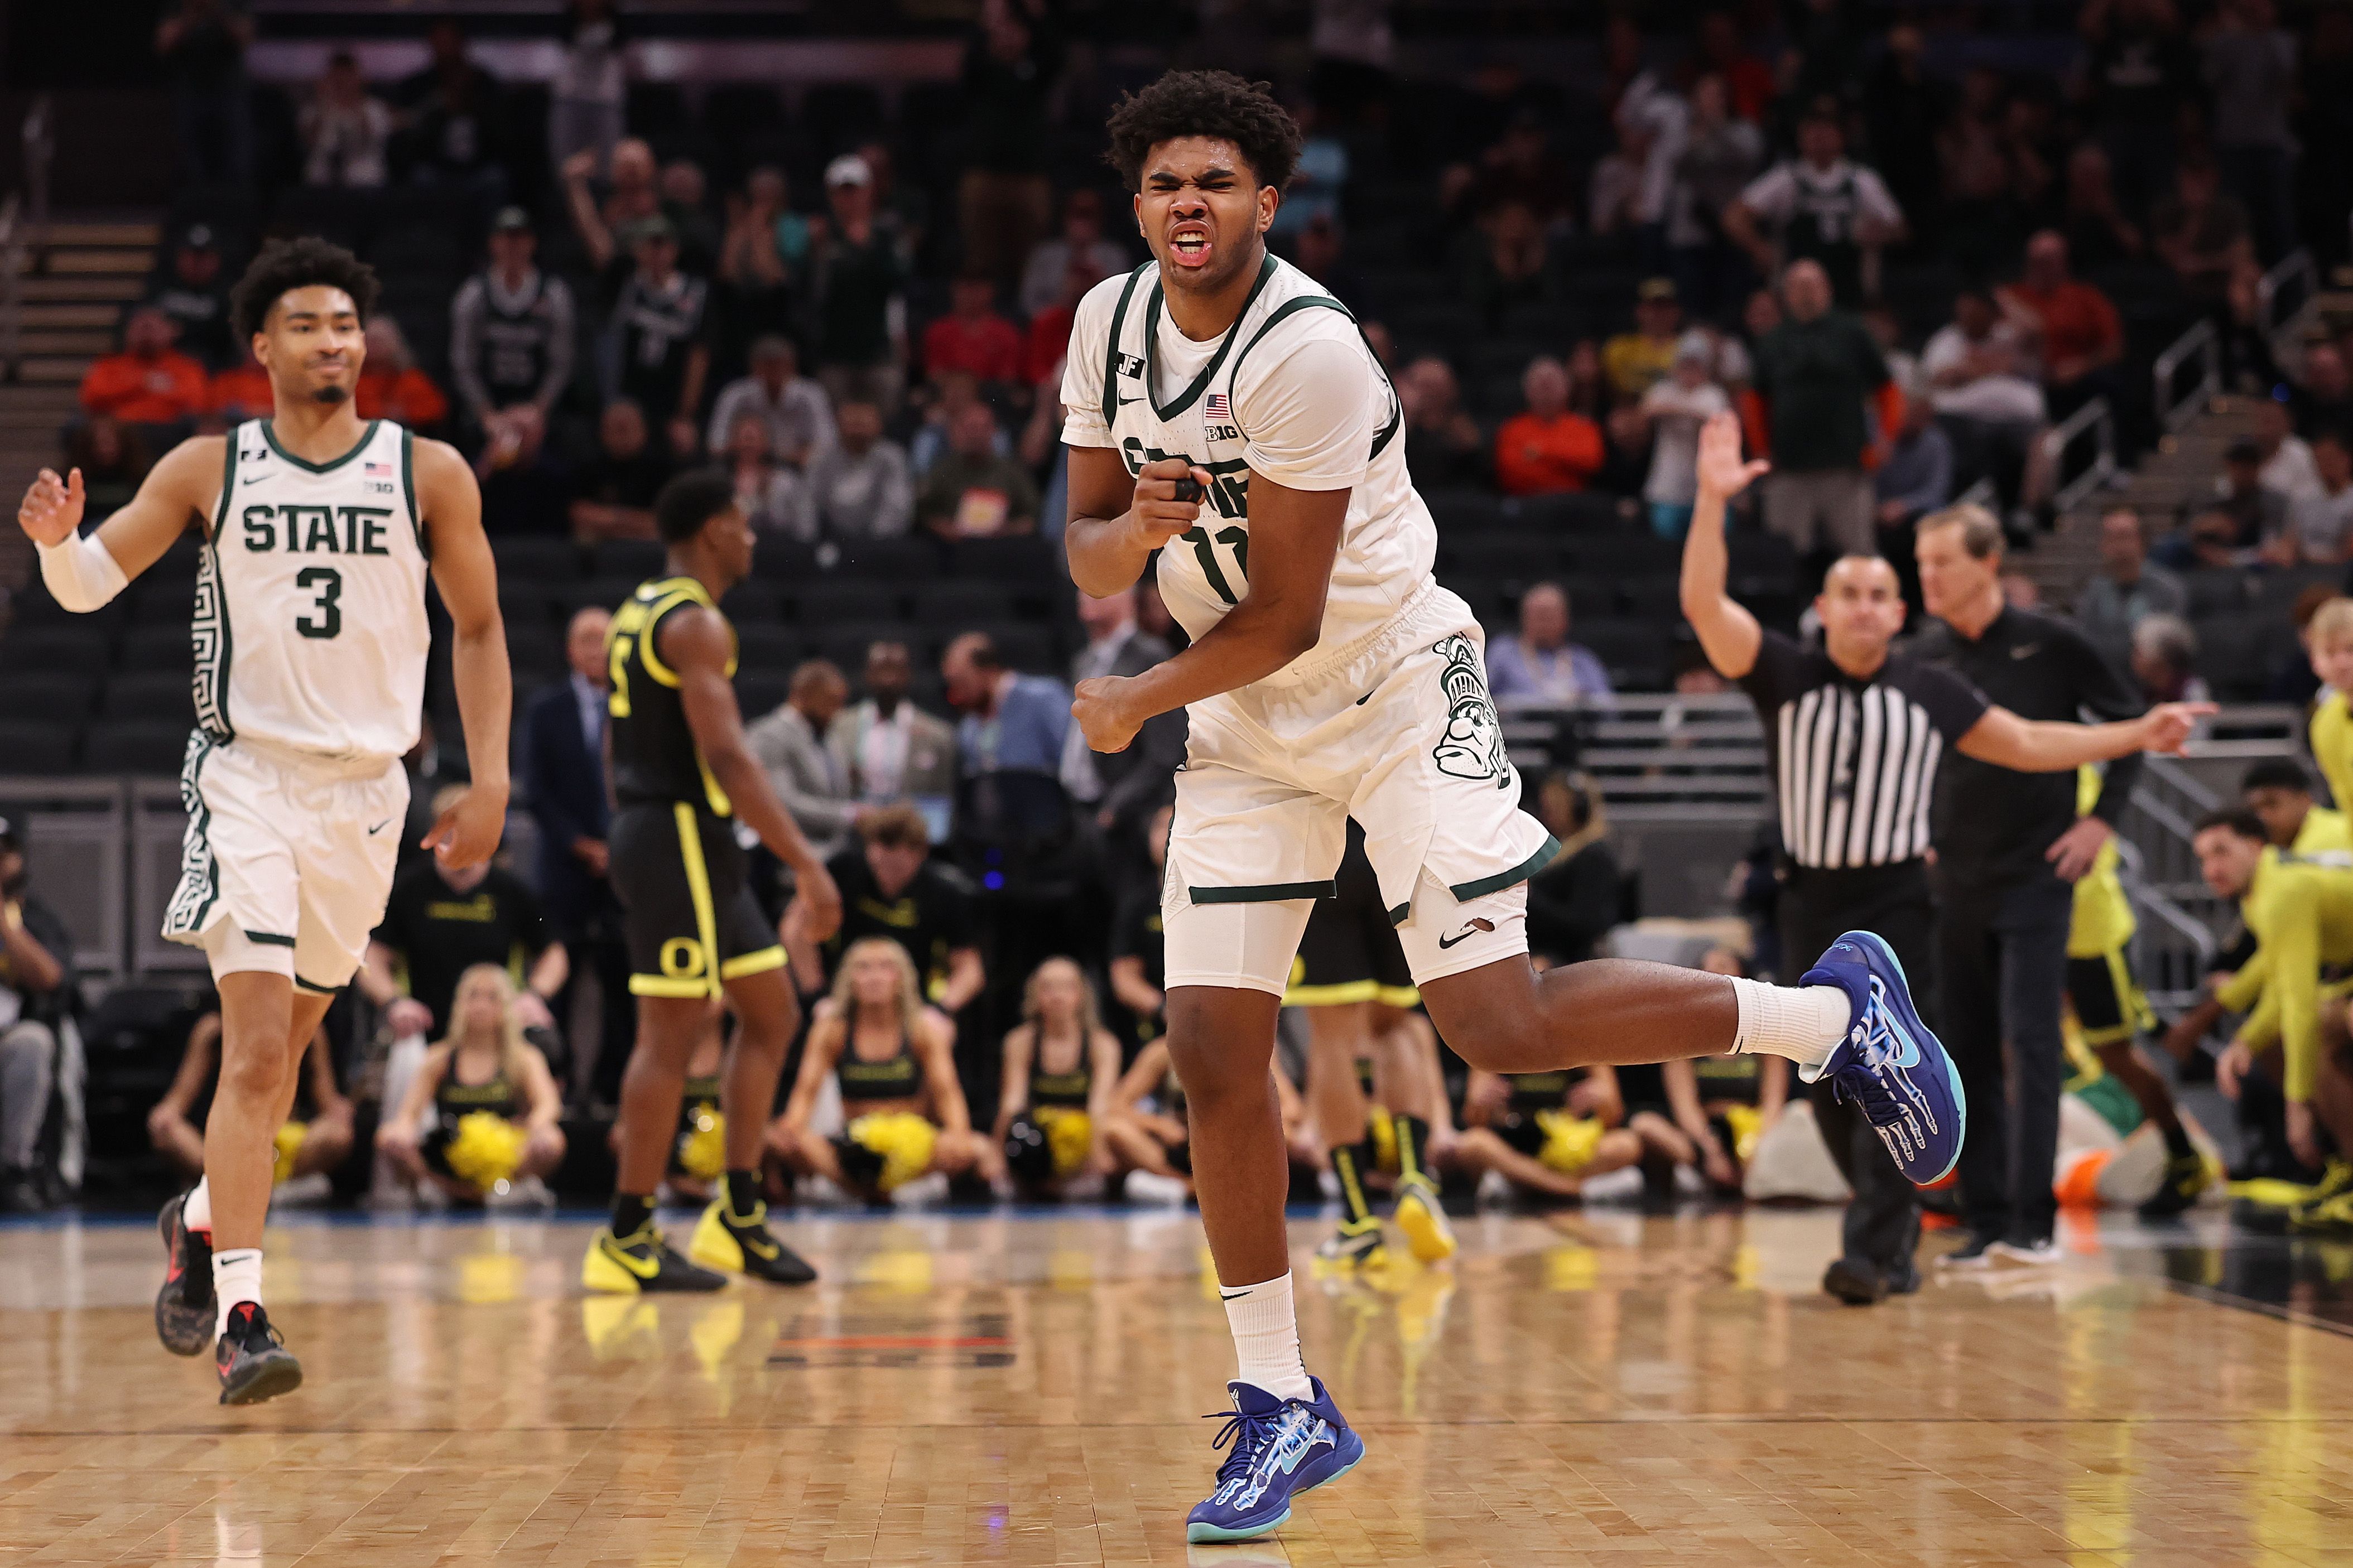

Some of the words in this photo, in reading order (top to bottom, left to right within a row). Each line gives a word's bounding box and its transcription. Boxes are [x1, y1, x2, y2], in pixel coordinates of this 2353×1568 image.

[1118, 354, 1139, 376] JF
[243, 505, 393, 555] STATE
[297, 568, 341, 639] 3
